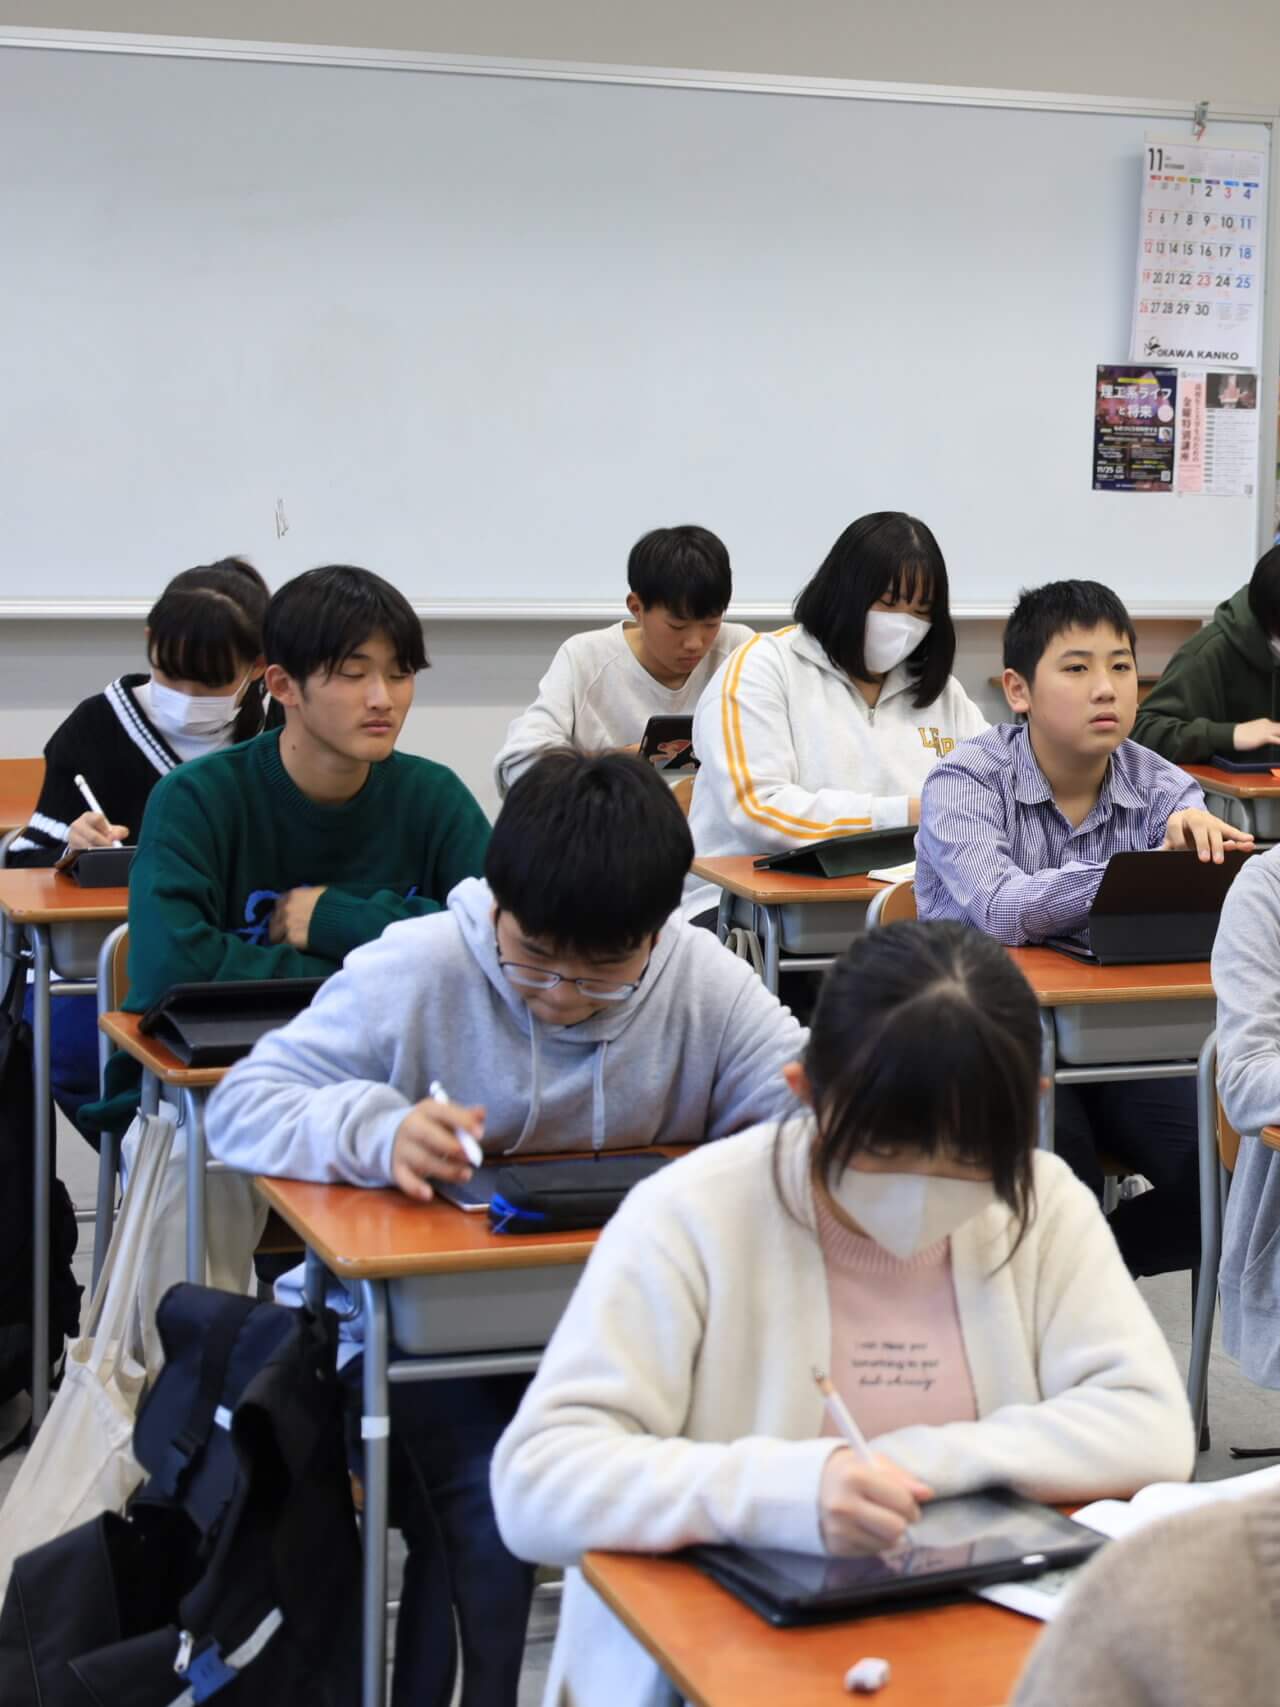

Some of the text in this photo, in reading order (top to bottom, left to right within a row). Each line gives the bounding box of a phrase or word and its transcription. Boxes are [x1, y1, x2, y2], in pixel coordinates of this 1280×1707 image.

[1148, 148, 1163, 171] 11
[1205, 185, 1213, 197] 2
[1224, 187, 1232, 199] 3
[1243, 188, 1251, 200] 4
[1160, 212, 1166, 224] 6
[1173, 213, 1179, 224] 7
[1186, 214, 1193, 226] 8
[1203, 215, 1211, 227] 9
[1221, 216, 1234, 229] 10
[1240, 218, 1251, 230] 11
[1156, 242, 1165, 254] 13
[1169, 243, 1178, 254] 14
[1183, 243, 1193, 256] 15
[1200, 245, 1212, 257] 16
[1220, 246, 1232, 257] 17
[1239, 247, 1252, 259] 18
[1153, 271, 1163, 284] 20
[1165, 272, 1175, 284] 21
[1180, 273, 1193, 285] 22
[1197, 274, 1212, 287] 23
[1216, 275, 1231, 287] 24
[1235, 276, 1250, 289] 25
[1151, 302, 1160, 313] 27
[1162, 302, 1174, 314] 28
[1176, 303, 1190, 315] 29
[1195, 304, 1210, 316] 30
[1197, 350, 1239, 361] KANKO
